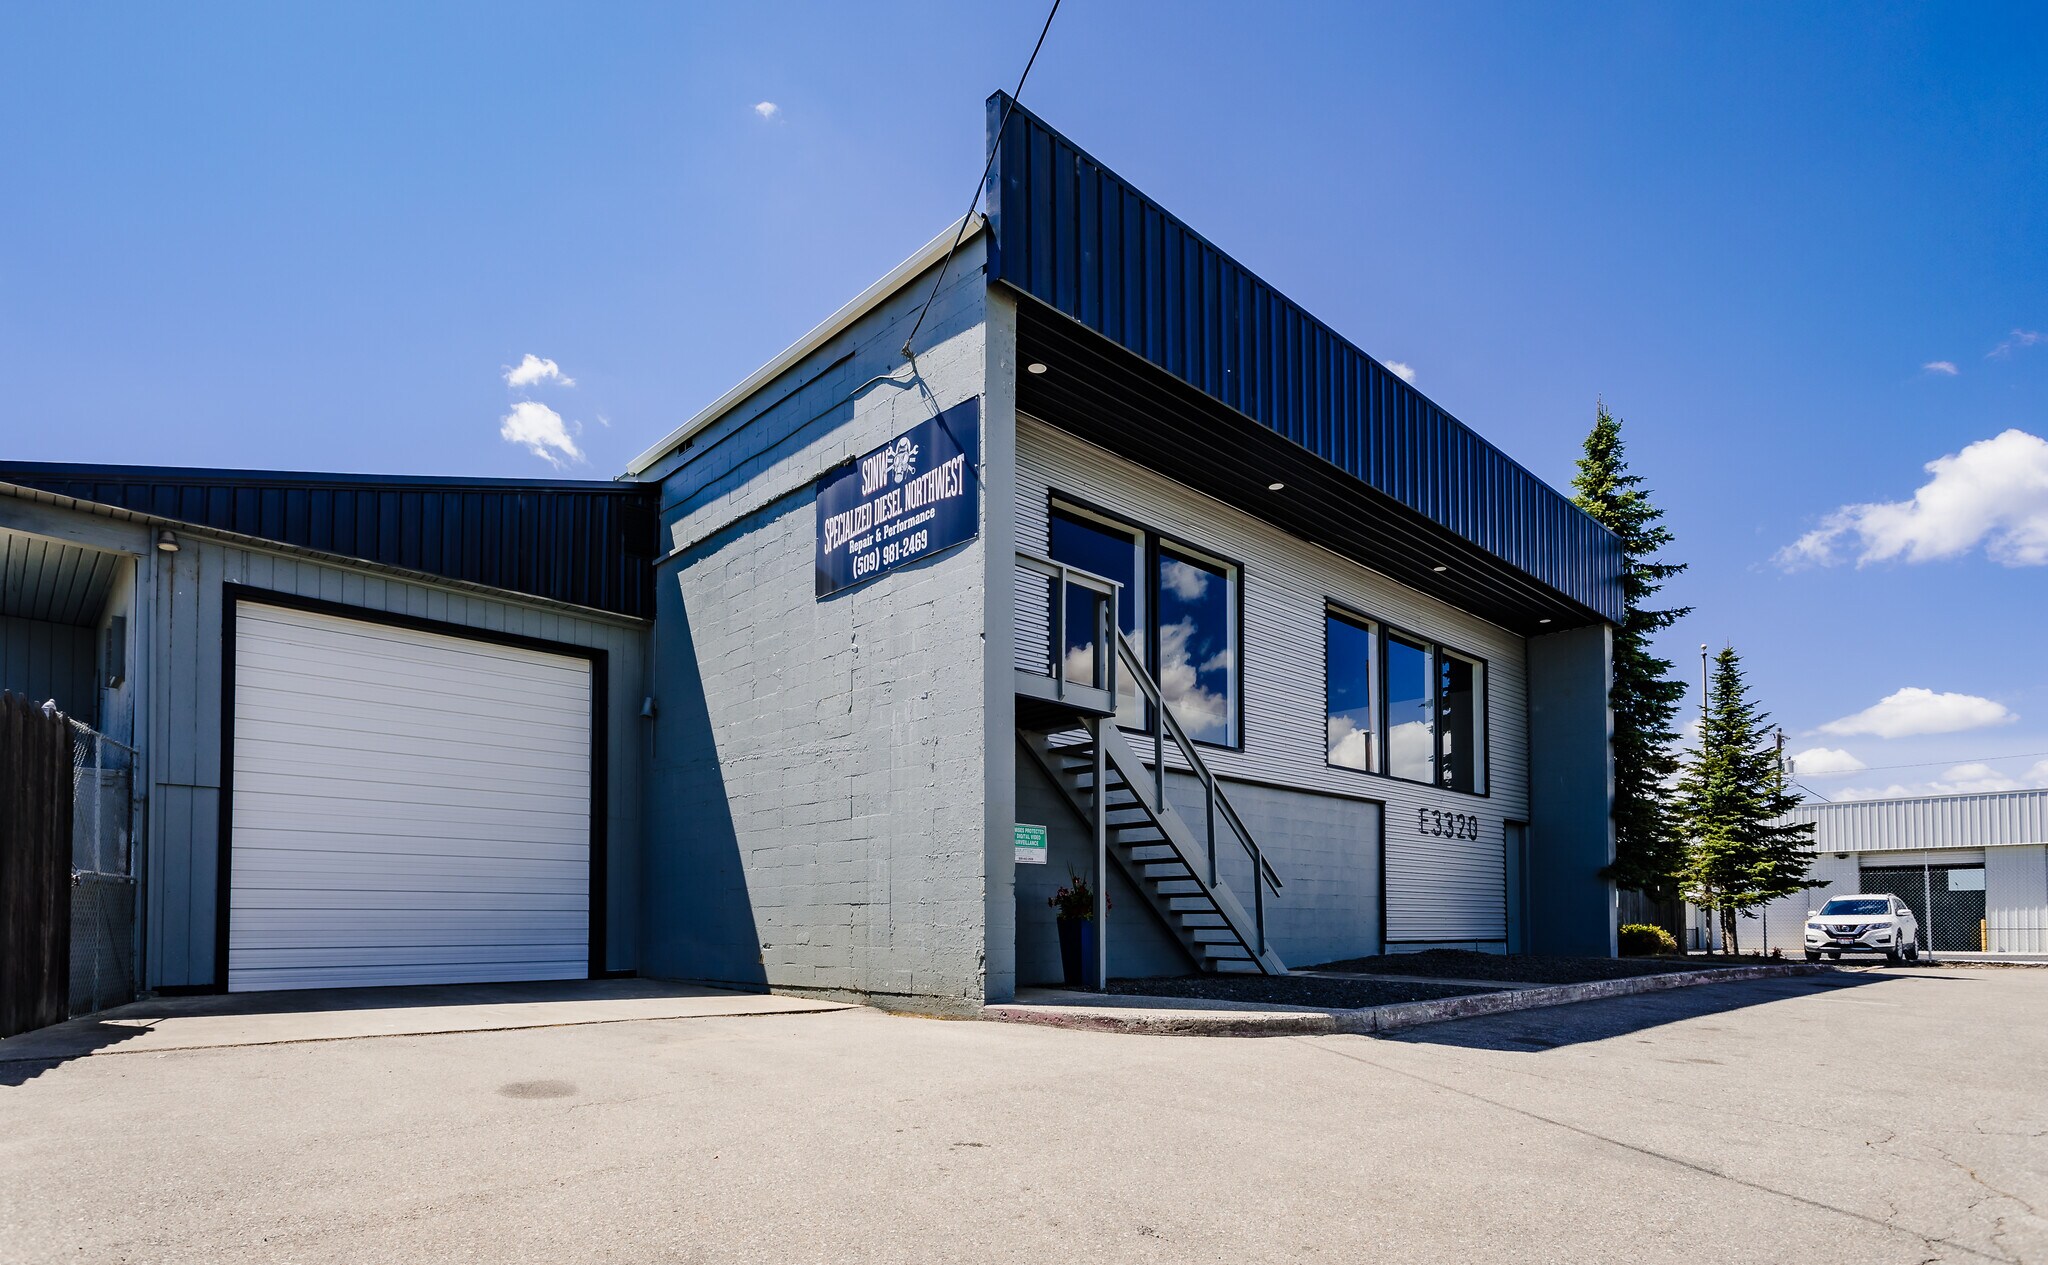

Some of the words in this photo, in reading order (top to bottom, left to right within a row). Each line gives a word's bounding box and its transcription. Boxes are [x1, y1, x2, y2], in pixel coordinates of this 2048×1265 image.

[862, 449, 889, 496] SDNW
[824, 501, 872, 555] SPECIALIZED
[874, 487, 903, 526] DIESEL
[904, 453, 965, 512] NORTHWEST
[849, 534, 874, 554] Repair
[875, 528, 882, 543] &
[883, 507, 936, 540] Performance
[852, 547, 880, 579] (509)
[883, 529, 928, 566] 981-2469
[1419, 808, 1478, 841] E3320
